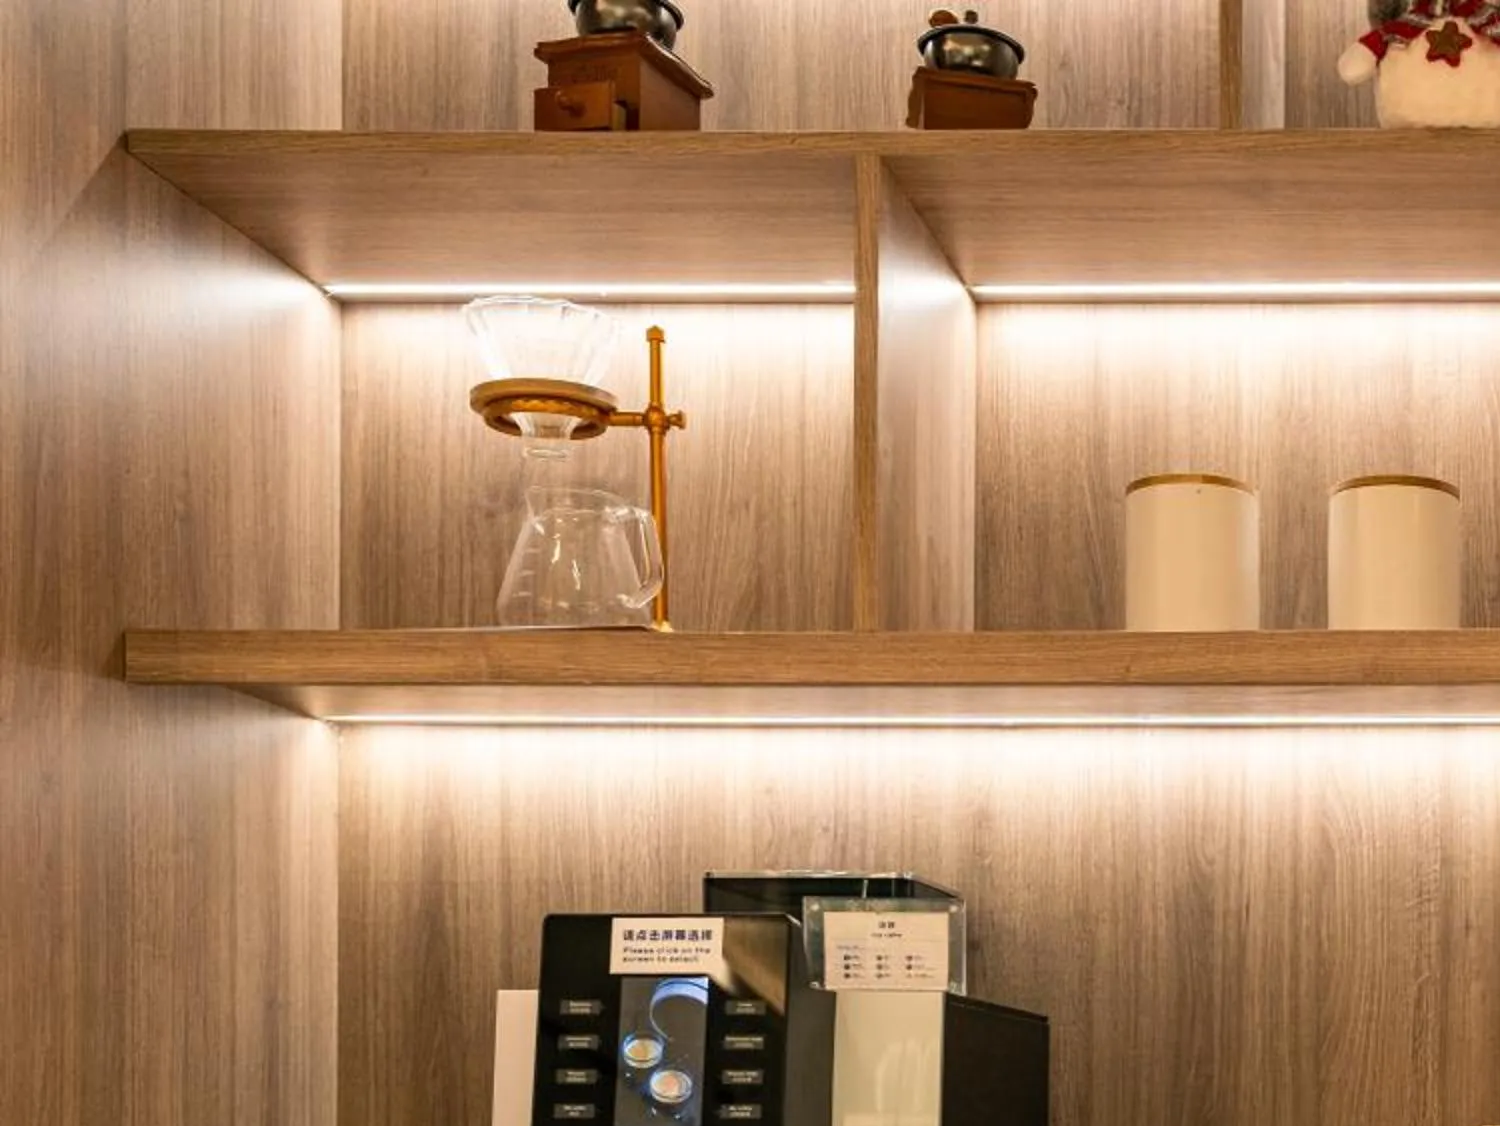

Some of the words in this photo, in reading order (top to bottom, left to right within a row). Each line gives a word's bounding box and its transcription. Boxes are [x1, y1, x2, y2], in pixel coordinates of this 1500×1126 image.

[623, 946, 654, 954] Please
[656, 946, 679, 954] click
[695, 946, 712, 954] the
